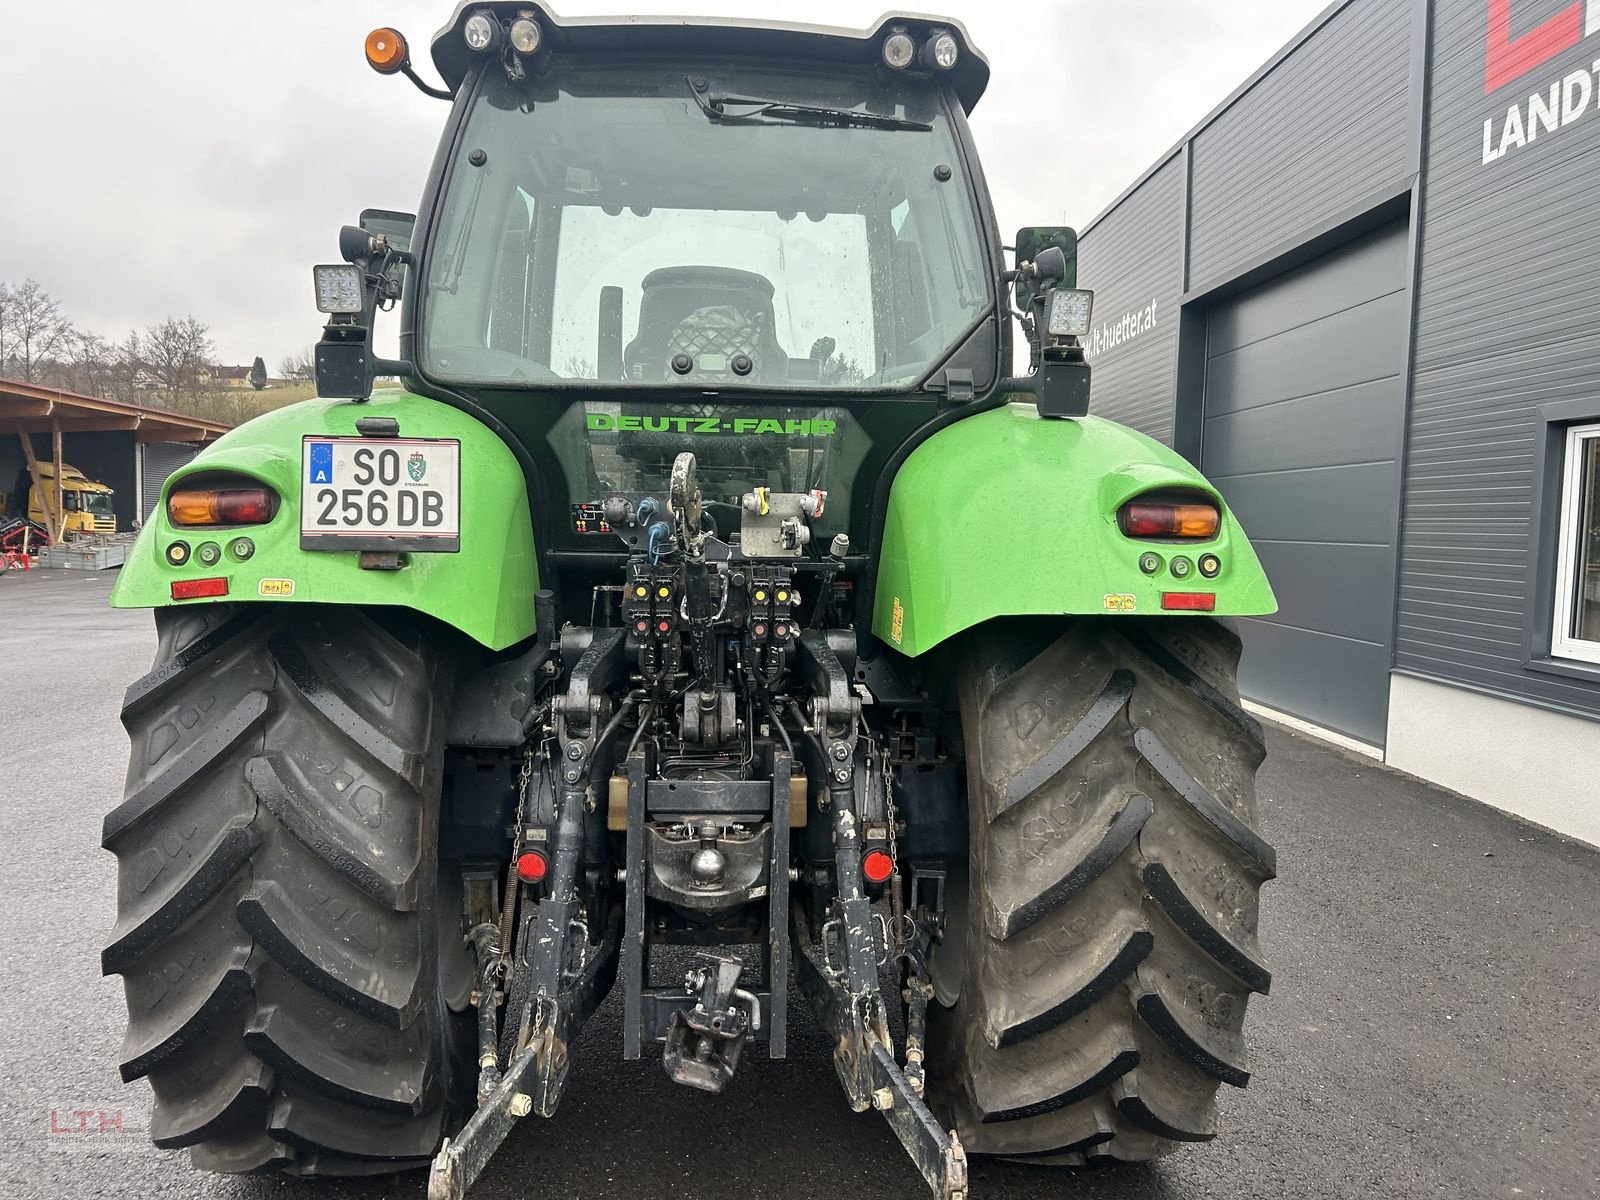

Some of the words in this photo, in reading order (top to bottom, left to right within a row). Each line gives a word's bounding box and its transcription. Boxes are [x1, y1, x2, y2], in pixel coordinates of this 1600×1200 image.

[586, 413, 837, 435] DEUTZ-FAHR
[315, 470, 327, 482] A
[353, 448, 400, 486] SO
[317, 488, 388, 526] 256
[397, 490, 443, 527] DB
